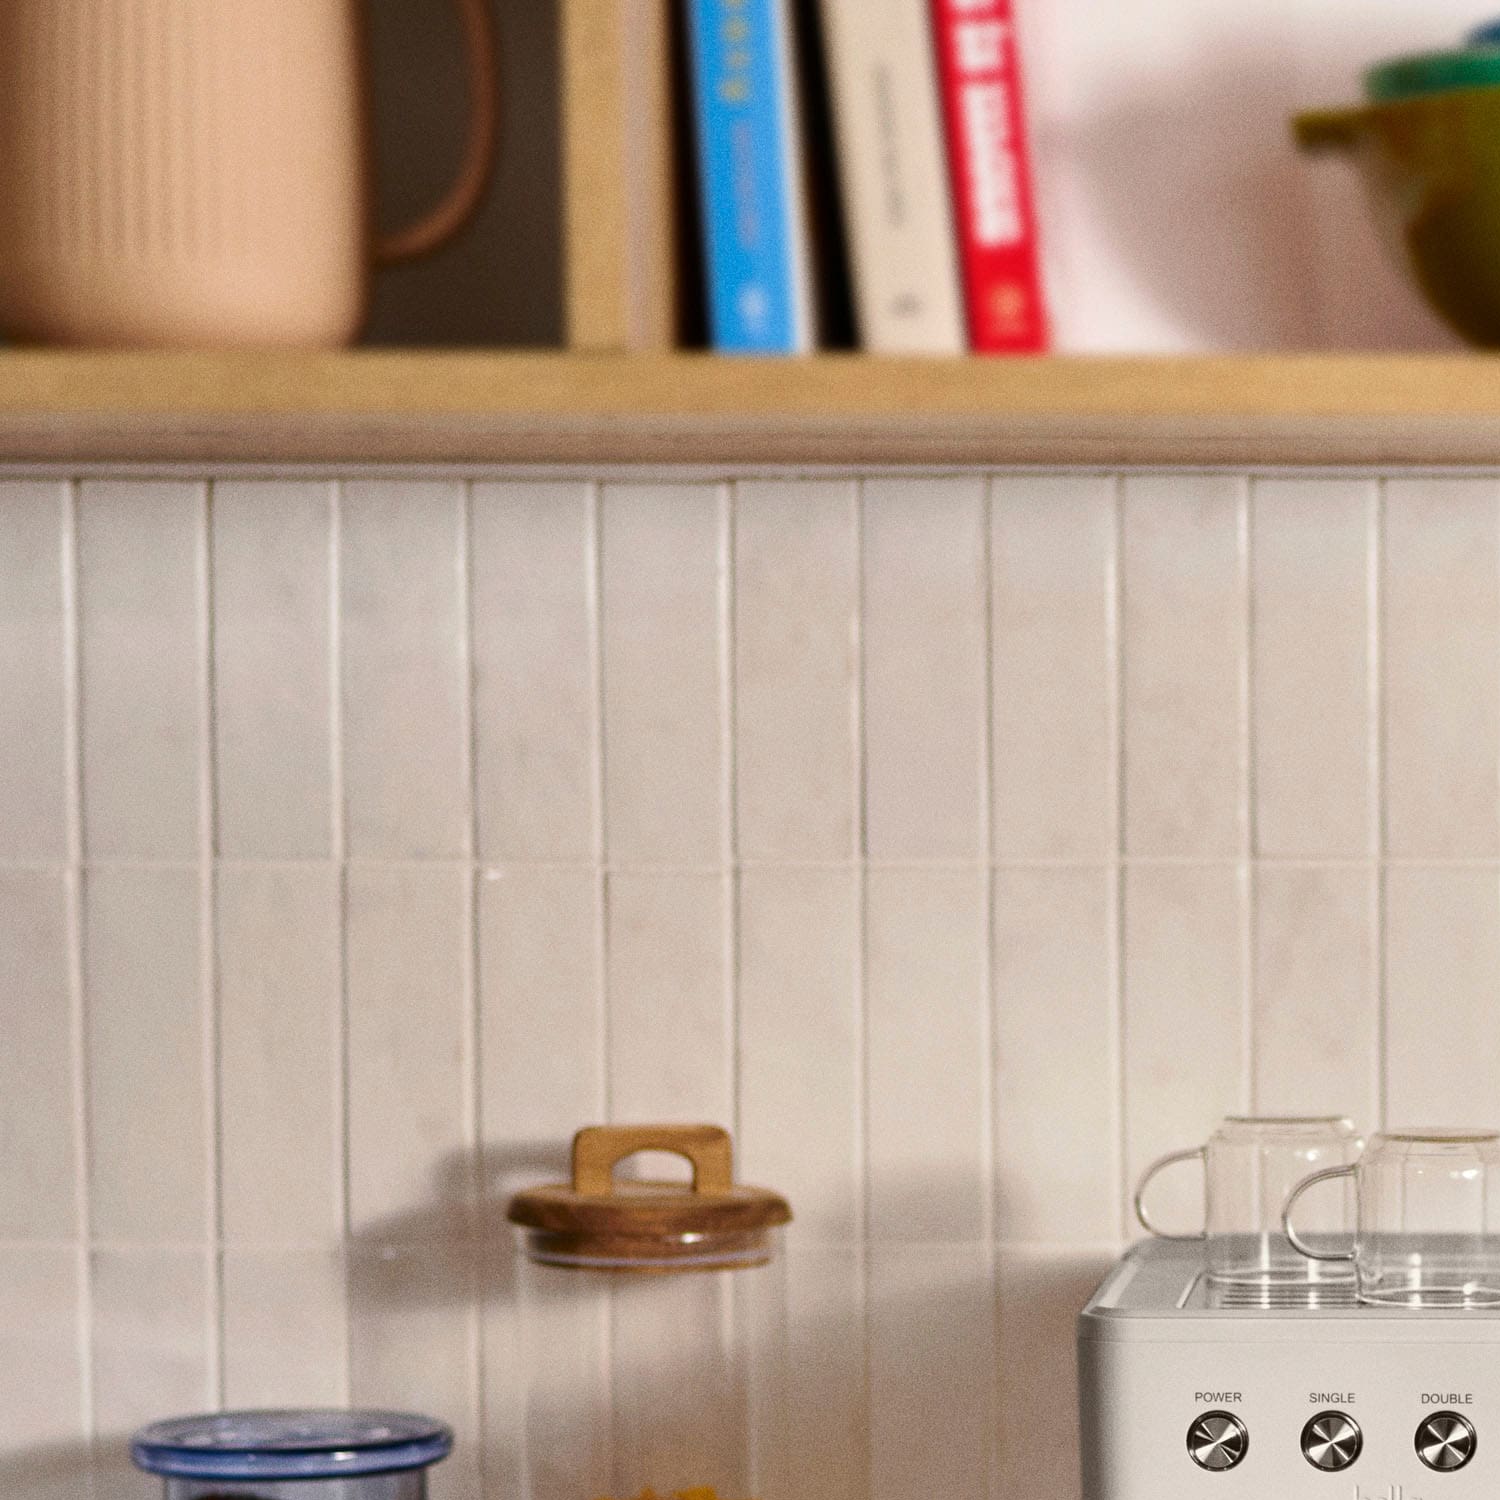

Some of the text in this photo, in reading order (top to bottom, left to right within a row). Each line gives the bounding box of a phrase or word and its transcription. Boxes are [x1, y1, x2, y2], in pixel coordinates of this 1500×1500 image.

[1194, 1391, 1242, 1403] POWER
[1308, 1392, 1356, 1404] SINGLE
[1421, 1393, 1473, 1405] DOUBLE
